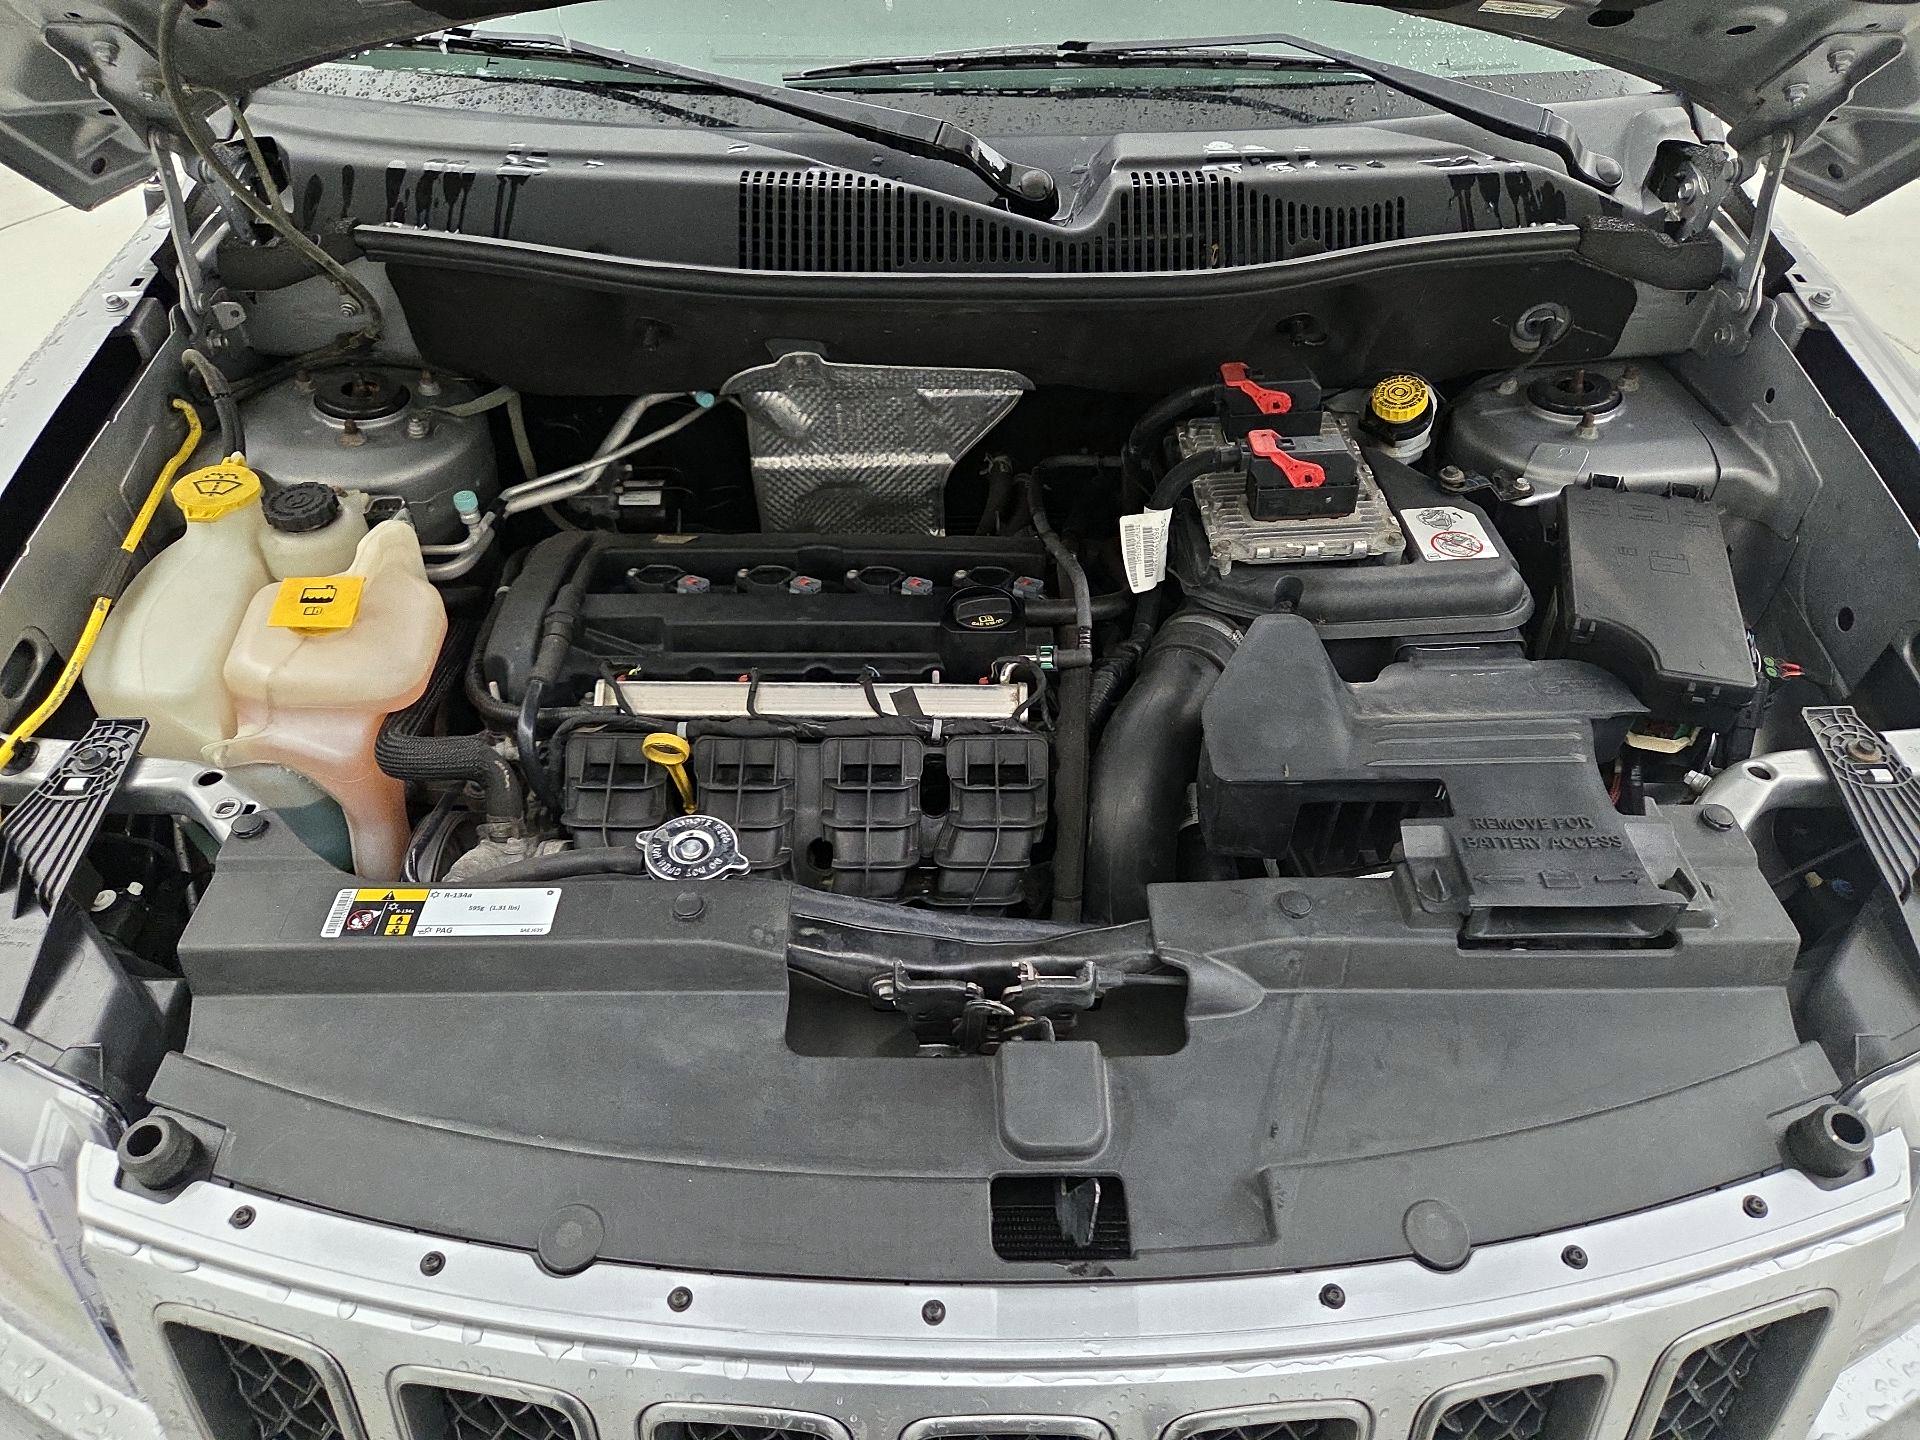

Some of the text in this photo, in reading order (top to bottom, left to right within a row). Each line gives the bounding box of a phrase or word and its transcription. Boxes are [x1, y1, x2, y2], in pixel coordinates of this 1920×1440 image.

[1471, 816, 1595, 830] REMOVE FOR
[1462, 835, 1623, 850] BATTERY ACCESS
[685, 866, 706, 877] NOT
